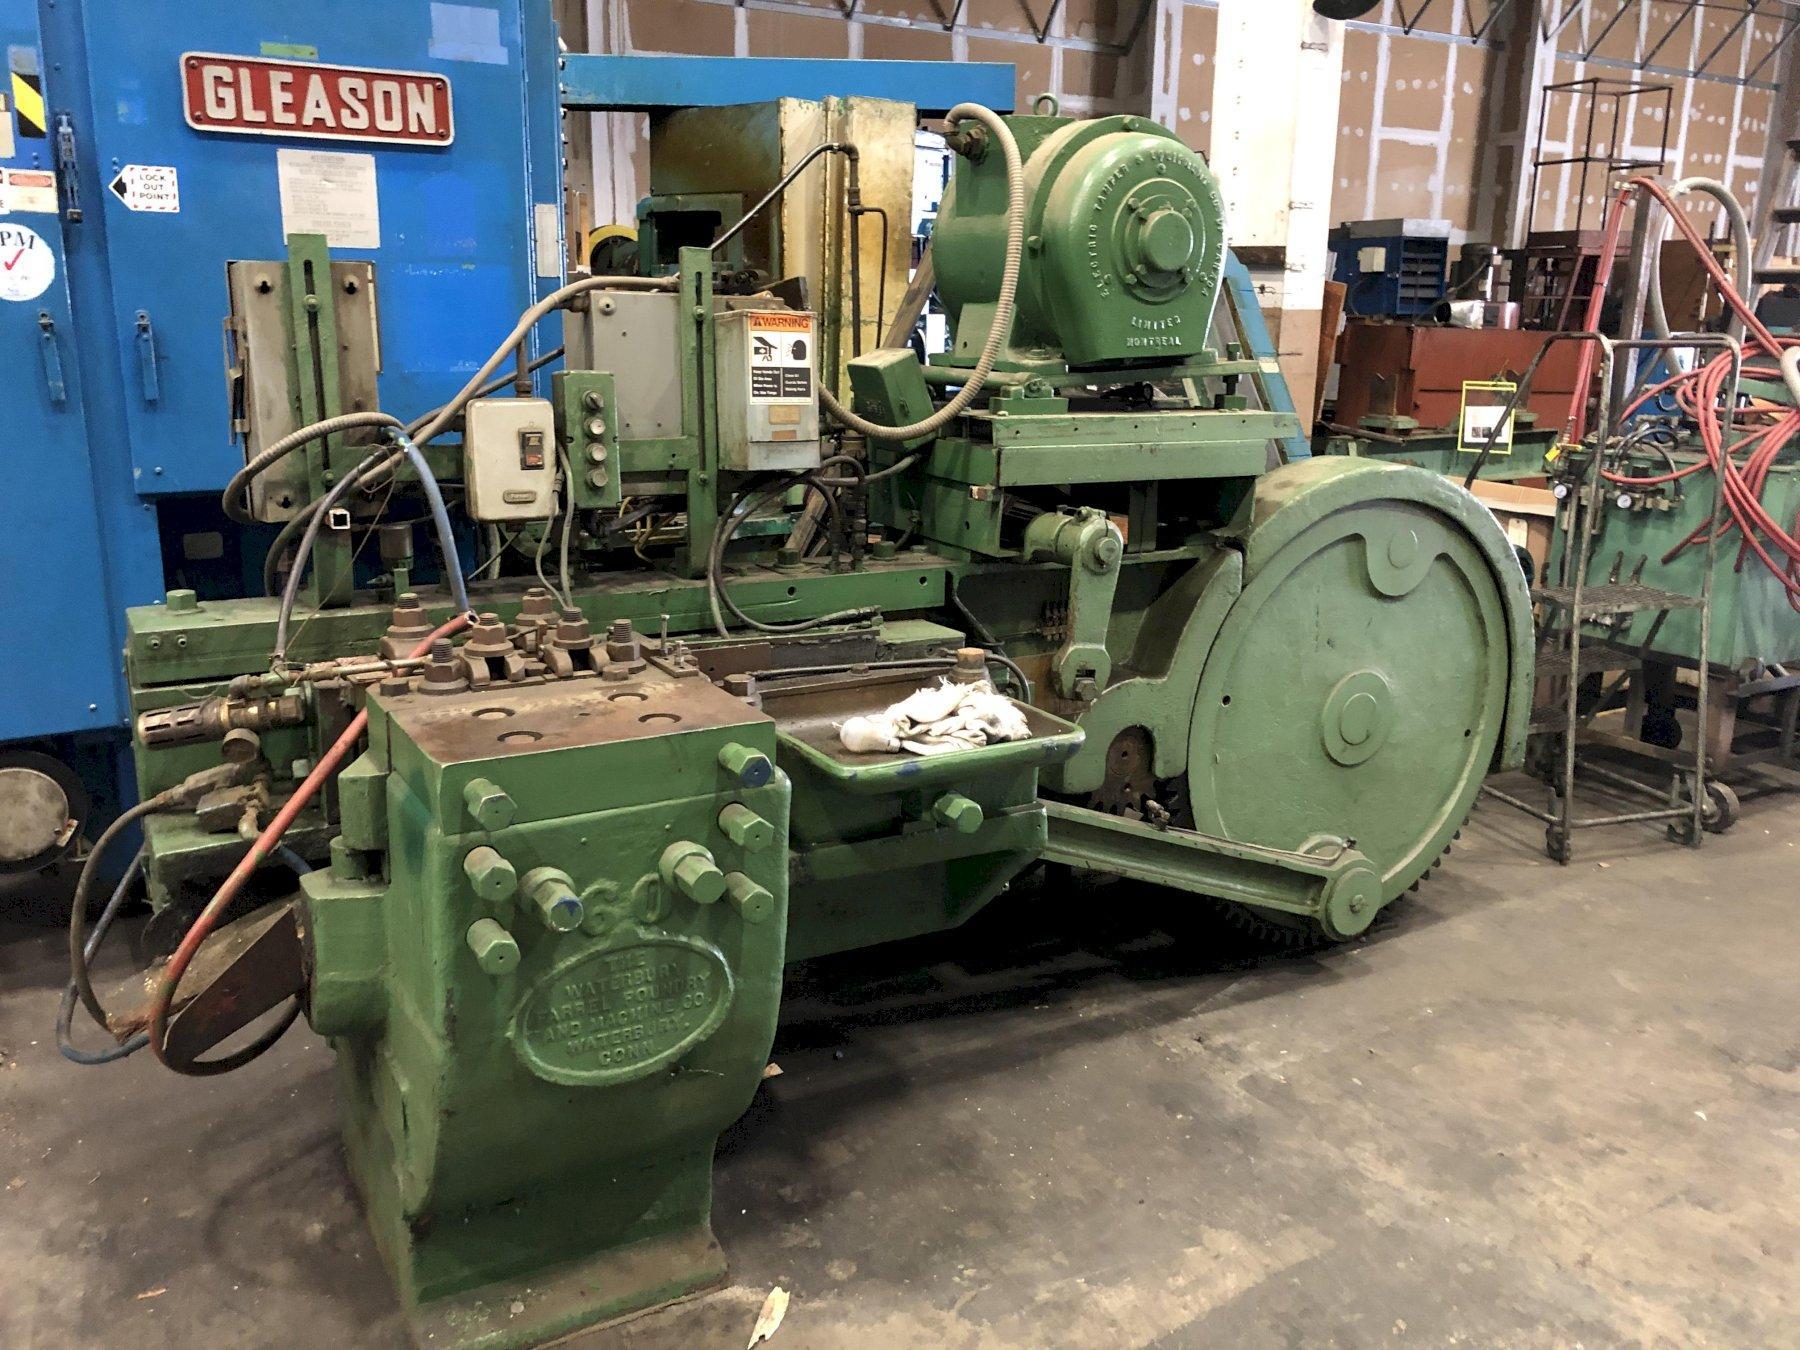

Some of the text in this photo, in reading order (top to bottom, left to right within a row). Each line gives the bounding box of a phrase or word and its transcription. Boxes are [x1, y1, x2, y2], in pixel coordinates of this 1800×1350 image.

[202, 65, 438, 134] GLEASON
[1094, 163, 1130, 212] TAMPER
[763, 316, 809, 328] WARNING
[1131, 315, 1181, 330] LIMITED
[1126, 336, 1181, 347] MONTREAL
